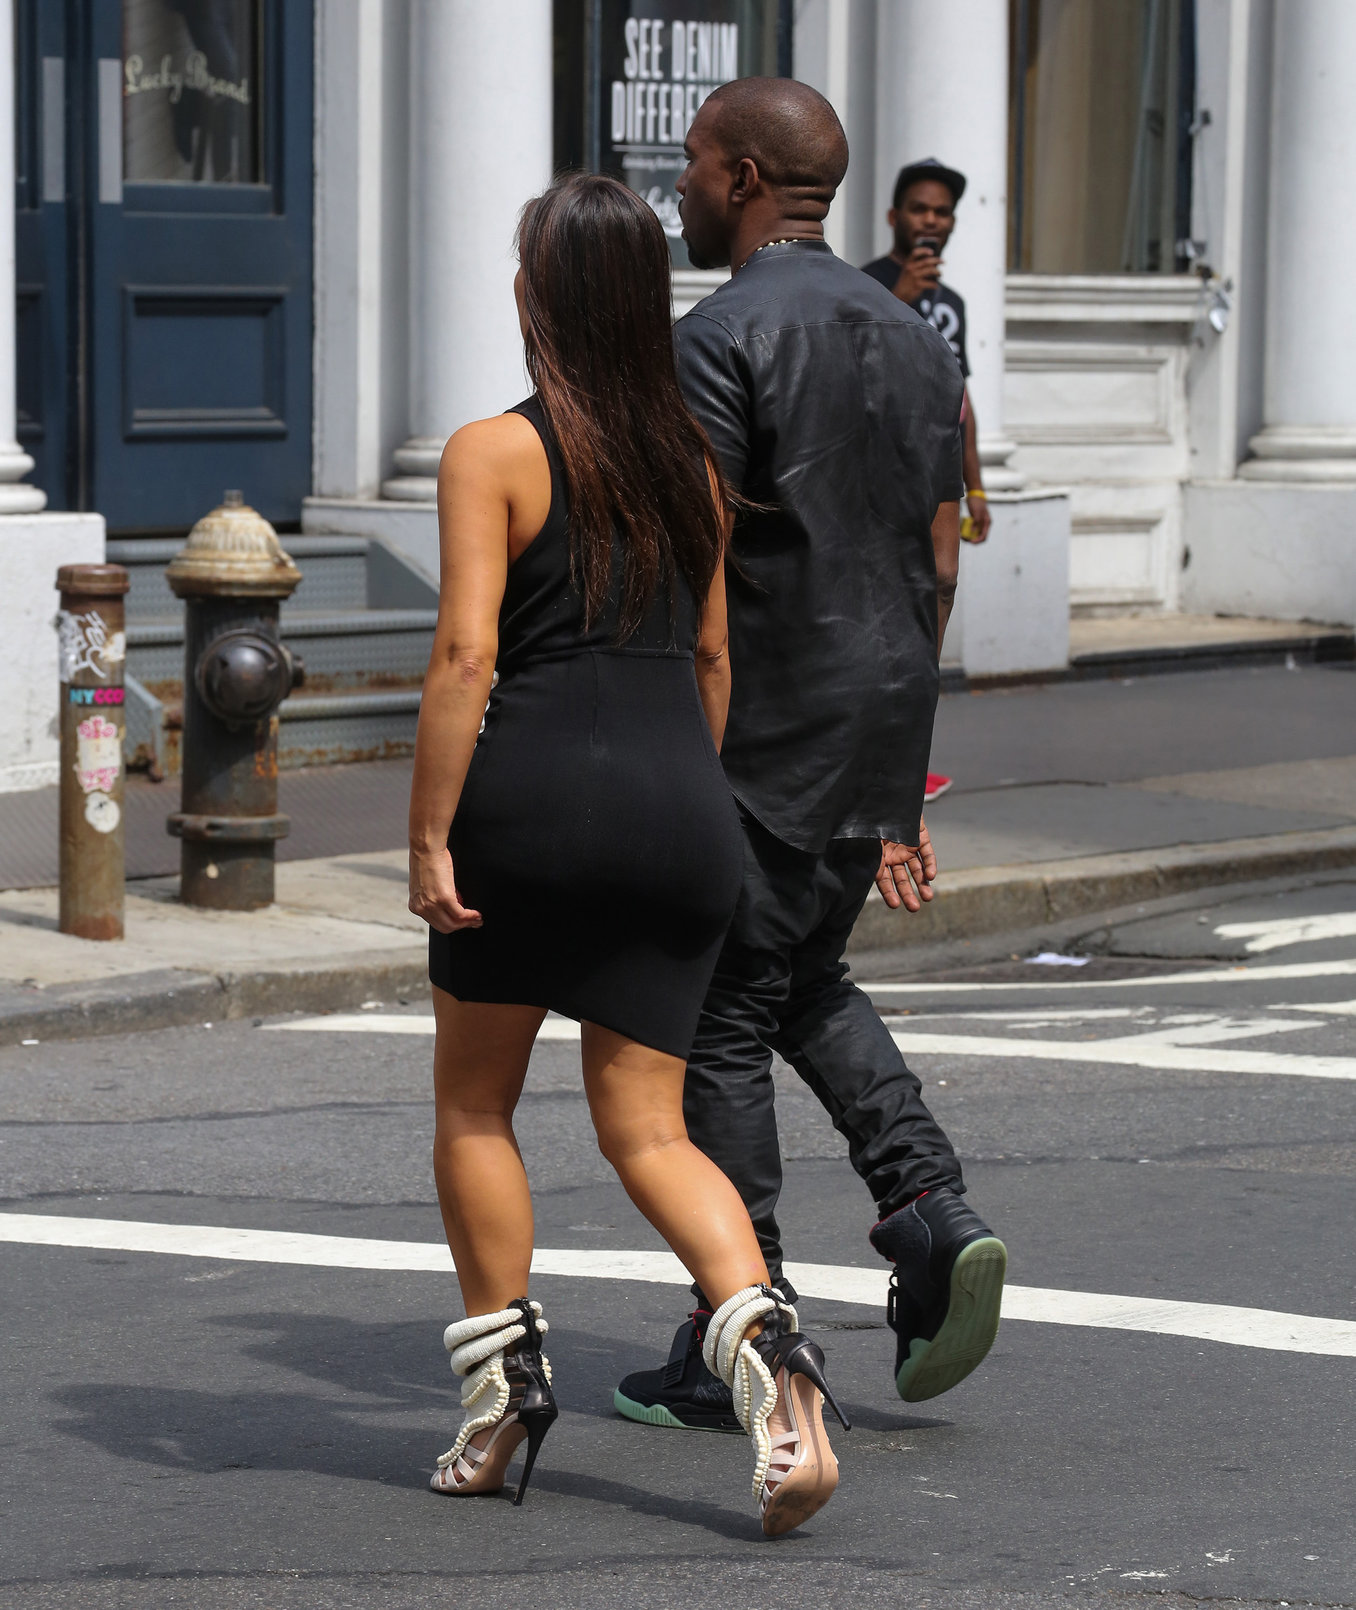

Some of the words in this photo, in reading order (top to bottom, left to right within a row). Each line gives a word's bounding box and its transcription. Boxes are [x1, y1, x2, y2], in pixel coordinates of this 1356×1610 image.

[124, 54, 182, 103] Lucky
[185, 50, 249, 104] Brand
[624, 17, 664, 80] SEE
[671, 20, 738, 82] DENIM
[611, 80, 721, 143] DIFFERE
